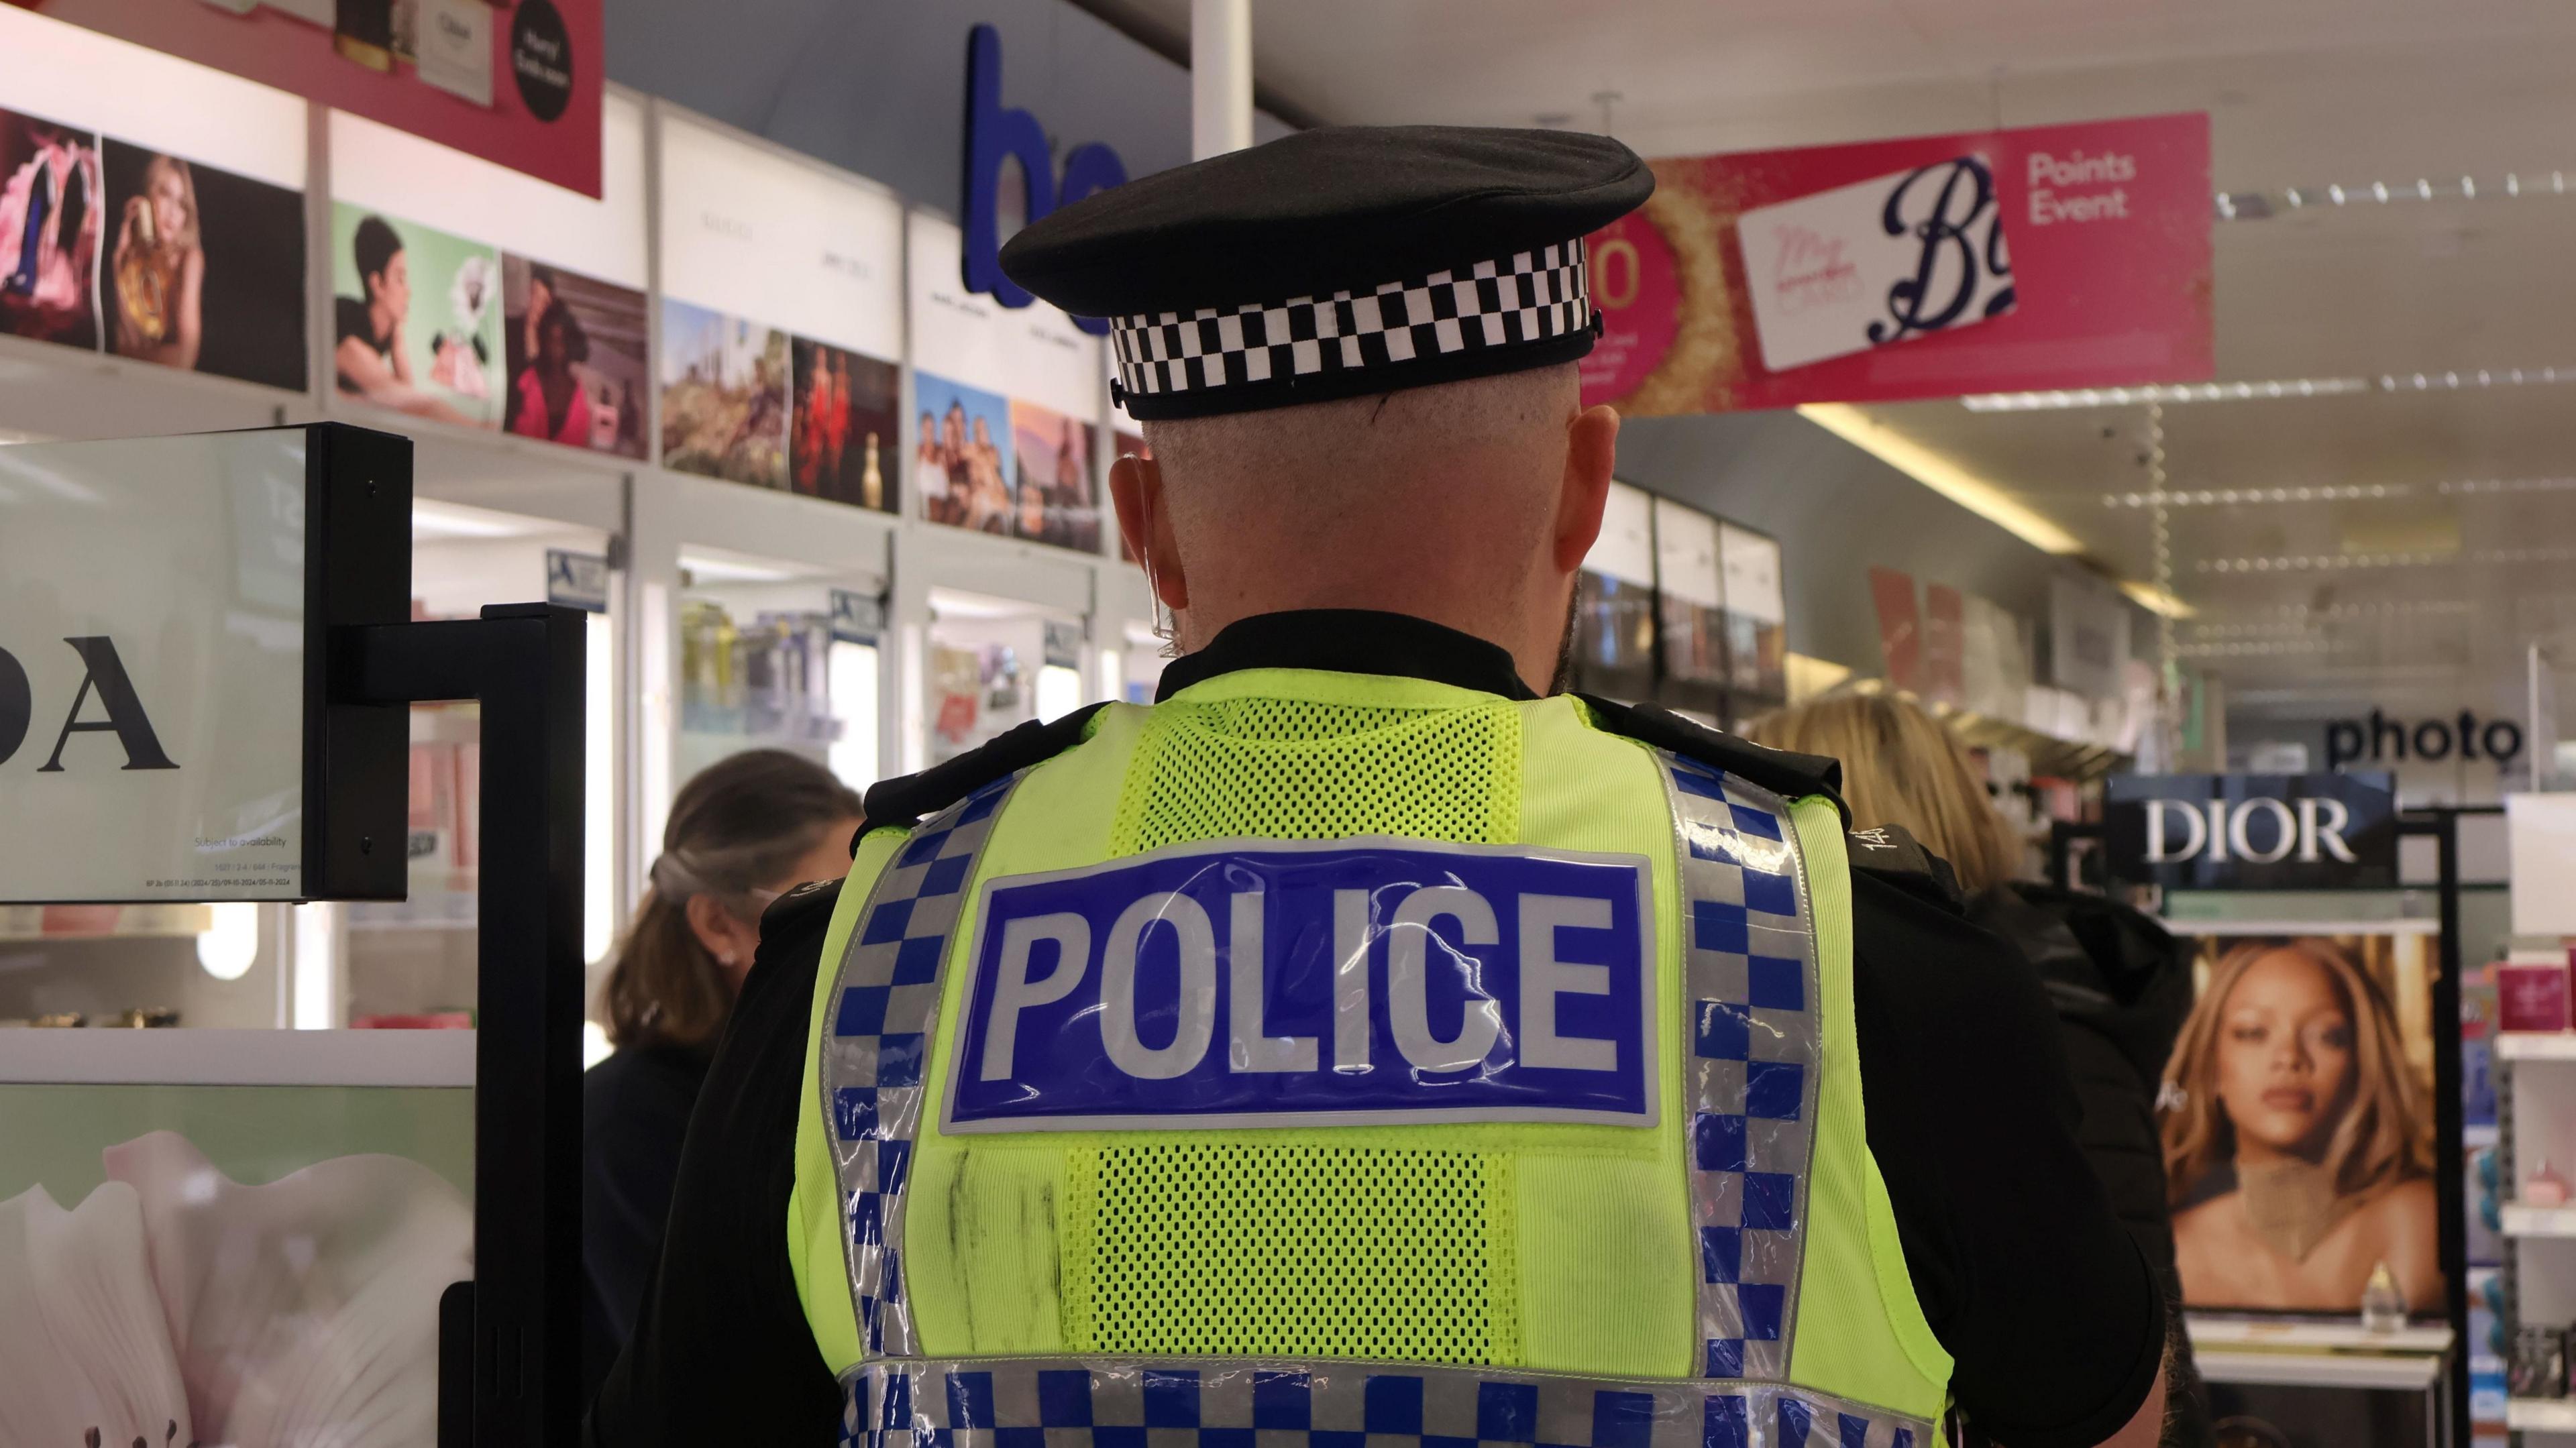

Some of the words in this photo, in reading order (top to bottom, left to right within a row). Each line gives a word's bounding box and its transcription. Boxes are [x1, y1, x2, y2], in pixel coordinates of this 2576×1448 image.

[2027, 150, 2136, 186] Points
[2027, 189, 2131, 226] Event
[2325, 707, 2521, 772] photo
[195, 838, 225, 848] Subject
[229, 838, 237, 846] to
[240, 838, 287, 848] availability
[2143, 797, 2358, 864] DIOR
[979, 888, 1619, 1082] POLICE
